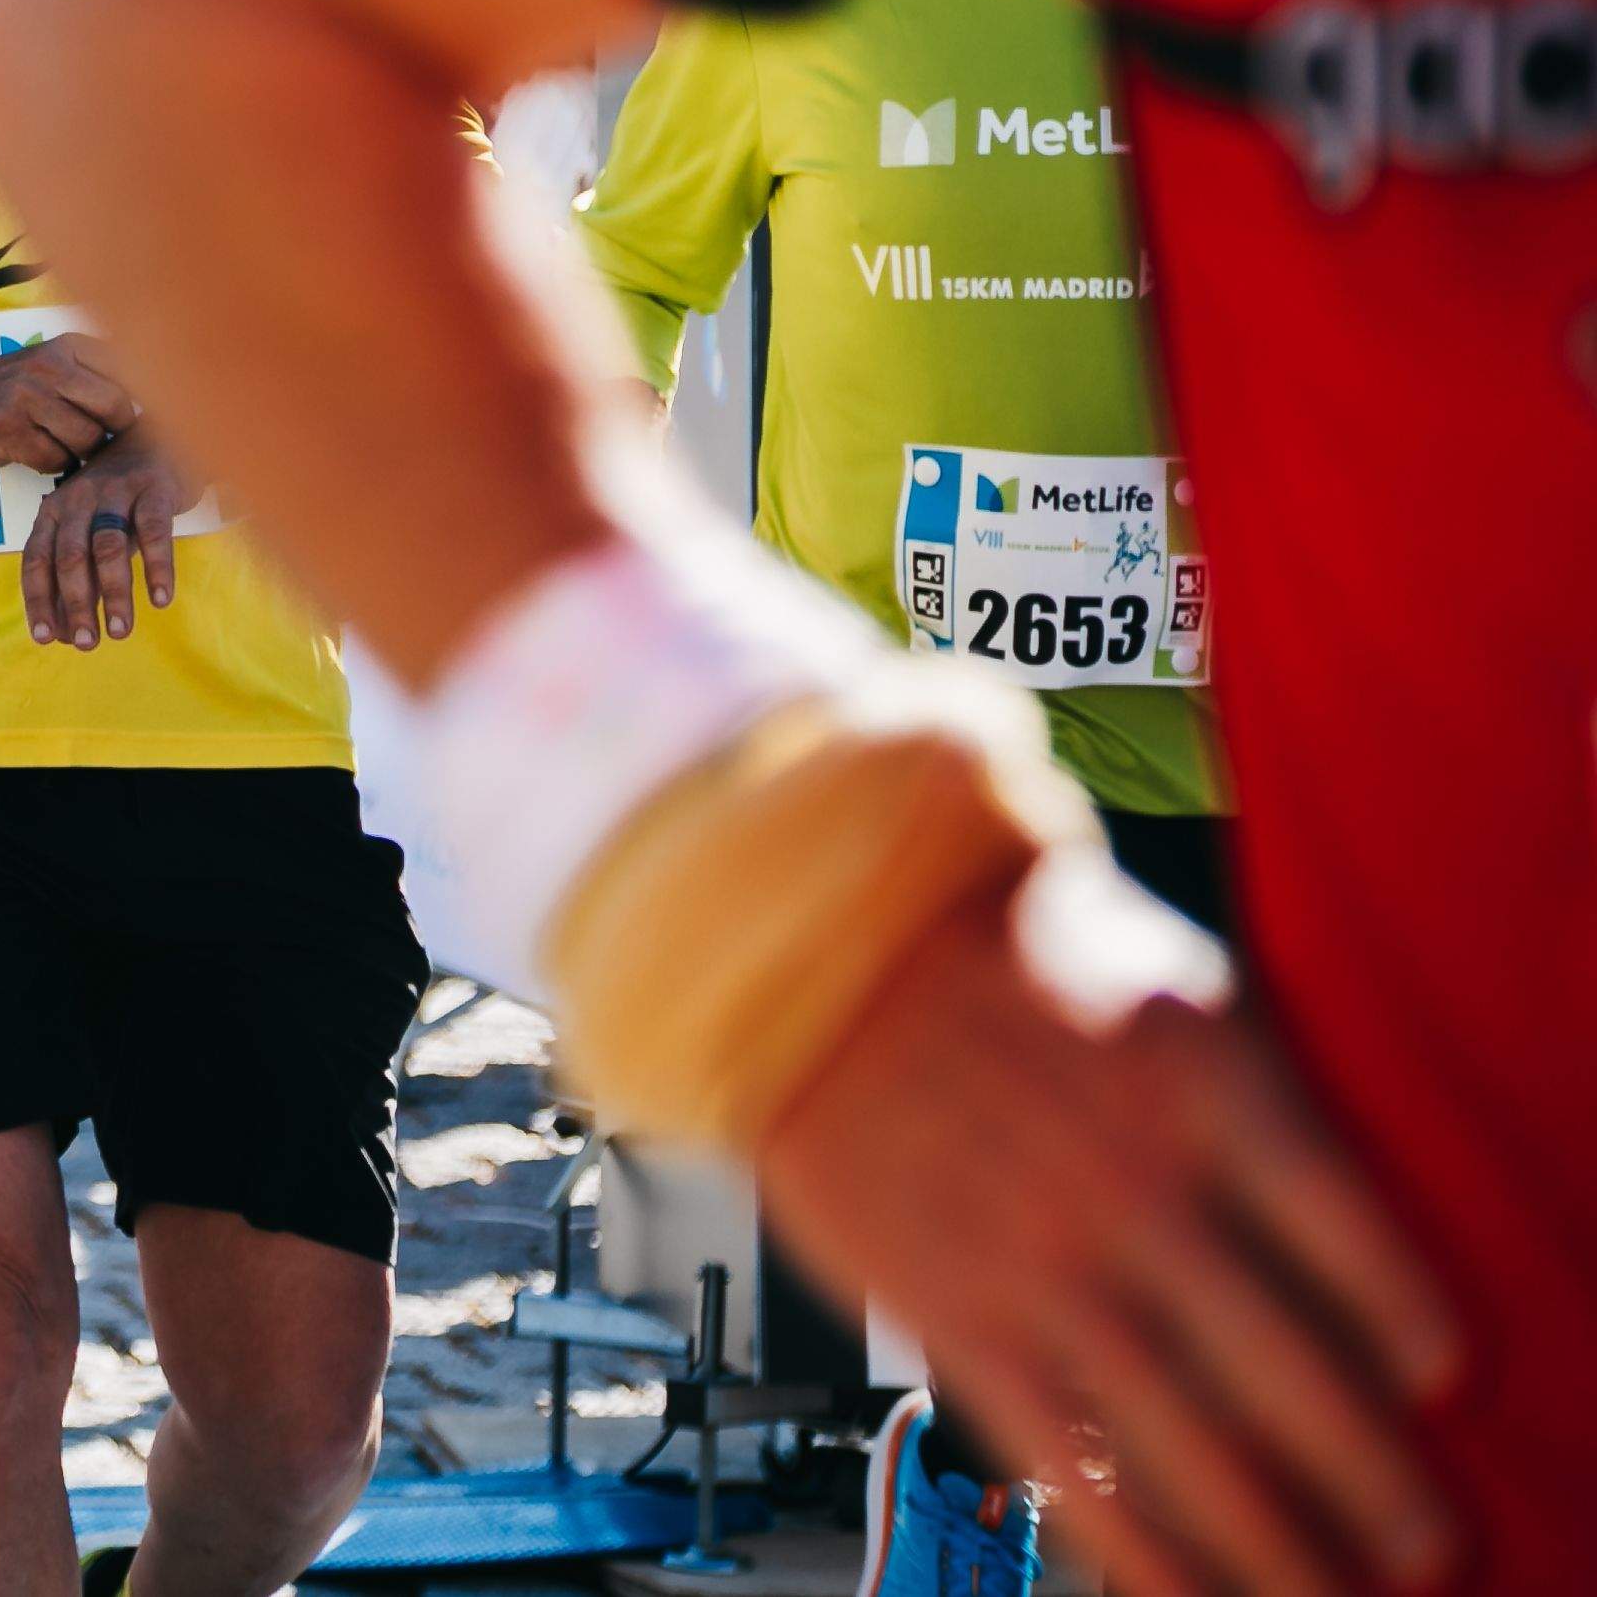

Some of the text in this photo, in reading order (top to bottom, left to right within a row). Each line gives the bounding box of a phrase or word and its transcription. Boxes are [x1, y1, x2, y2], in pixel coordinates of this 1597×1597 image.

[852, 243, 1133, 301] VIII 15KM MADRID
[1032, 484, 1154, 513] MetLife
[968, 589, 1149, 668] 2653
